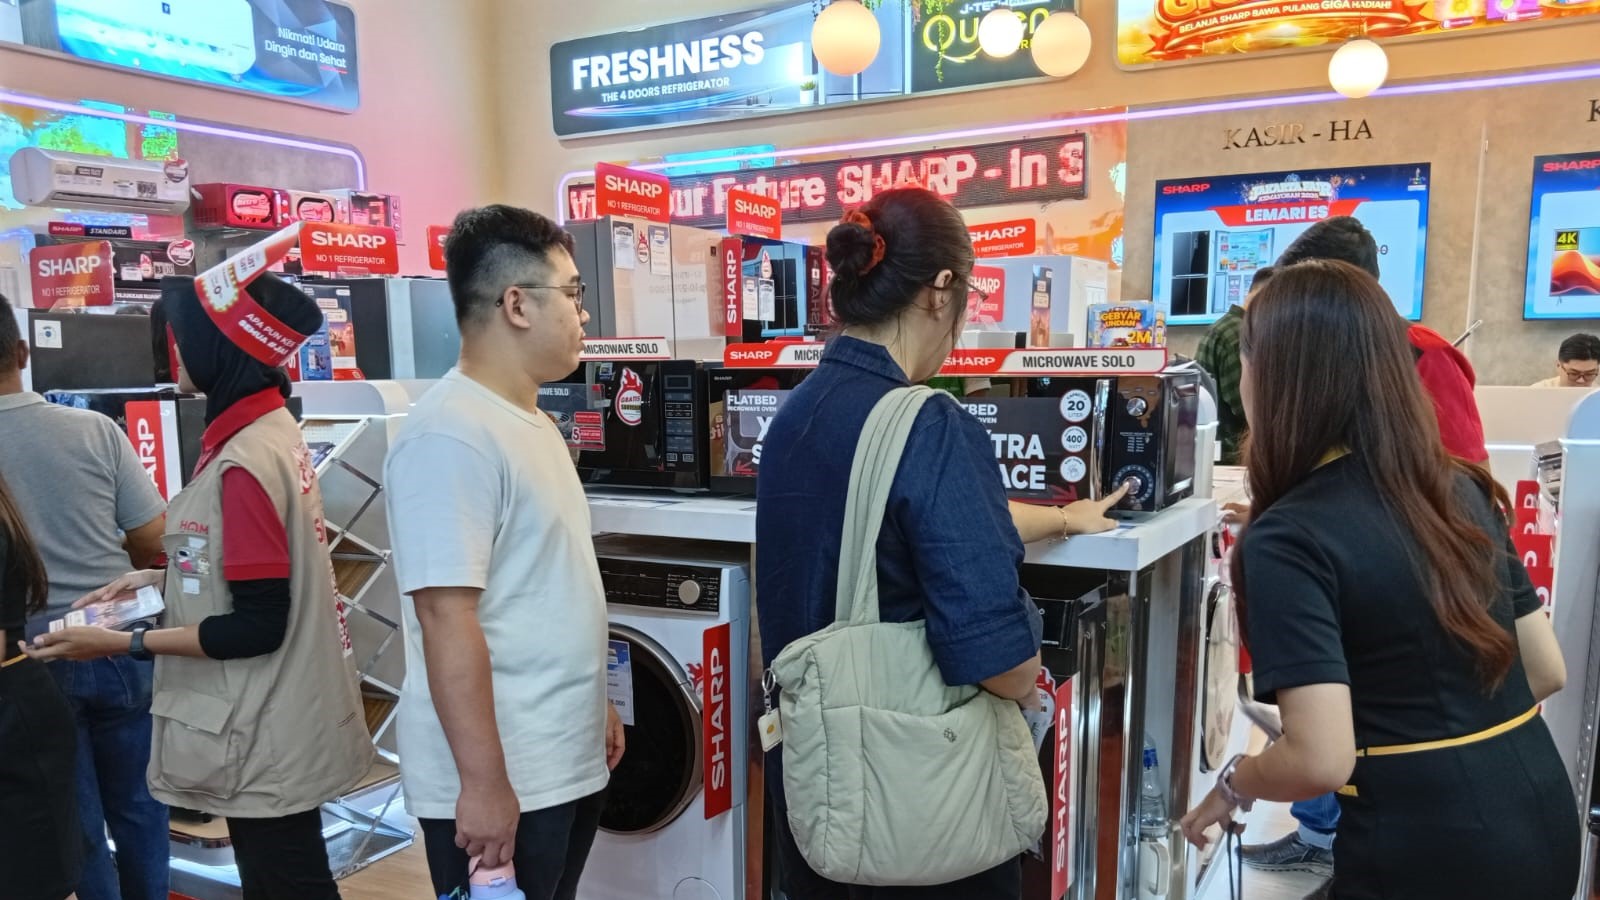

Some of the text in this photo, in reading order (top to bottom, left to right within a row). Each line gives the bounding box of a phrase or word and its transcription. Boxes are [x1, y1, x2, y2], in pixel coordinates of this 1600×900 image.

[1179, 16, 1218, 34] BELANJA
[1220, 11, 1251, 24] SHARP
[1252, 7, 1280, 18] BAWA
[1282, 2, 1320, 14] PULANG
[1321, 0, 1350, 10] GIGA
[1351, 0, 1392, 9] HADIAH!
[278, 27, 345, 52] Nikmati Udara
[264, 40, 347, 68] Dingin dan Sehat
[572, 31, 765, 91] FRESHNESS
[602, 76, 730, 103] THE 4 DOORS REFRIGERATOR
[1222, 122, 1306, 150] KASIR
[1328, 118, 1373, 141] HA
[1544, 158, 1600, 172] SHARP
[836, 153, 977, 204] SHARP
[1010, 148, 1048, 188] In
[605, 174, 662, 198] SHARP
[1162, 183, 1210, 195] SHARP
[607, 200, 616, 208] NO
[621, 202, 660, 216] REFRIGERATOR
[734, 199, 776, 219] SHARP
[1246, 205, 1328, 222] LEMARI ES
[90, 228, 128, 236] STANDARD
[746, 222, 774, 234] REFRIGERATOR
[968, 226, 1026, 242] SHARP
[312, 230, 386, 249] SHARP
[1557, 232, 1577, 244] 4K
[980, 242, 1024, 253] REFRIGERATOR
[38, 256, 101, 277] SHARP
[316, 254, 328, 262] NO
[334, 255, 386, 265] REFRIGERATOR
[42, 288, 50, 296] NO
[56, 284, 100, 296] REFRIGERATOR
[727, 250, 738, 324] SHARP
[1100, 312, 1142, 320] GEBYAR
[238, 320, 269, 344] SEMUA
[244, 314, 264, 329] APA
[264, 325, 282, 340] PUN
[1128, 331, 1151, 344] 2M
[584, 343, 658, 354] MICROWAVE SOLO
[730, 351, 773, 360] SHARP
[944, 355, 1135, 368] SHARP MICROWAVE SOLO
[554, 388, 569, 396] SOLO
[727, 395, 777, 406] FLATBED
[1068, 400, 1085, 411] 20
[572, 428, 580, 440] 5
[1066, 435, 1082, 443] 400
[986, 430, 1046, 460] TRA
[711, 648, 725, 791] SHARP
[1056, 708, 1068, 872] SHARP
